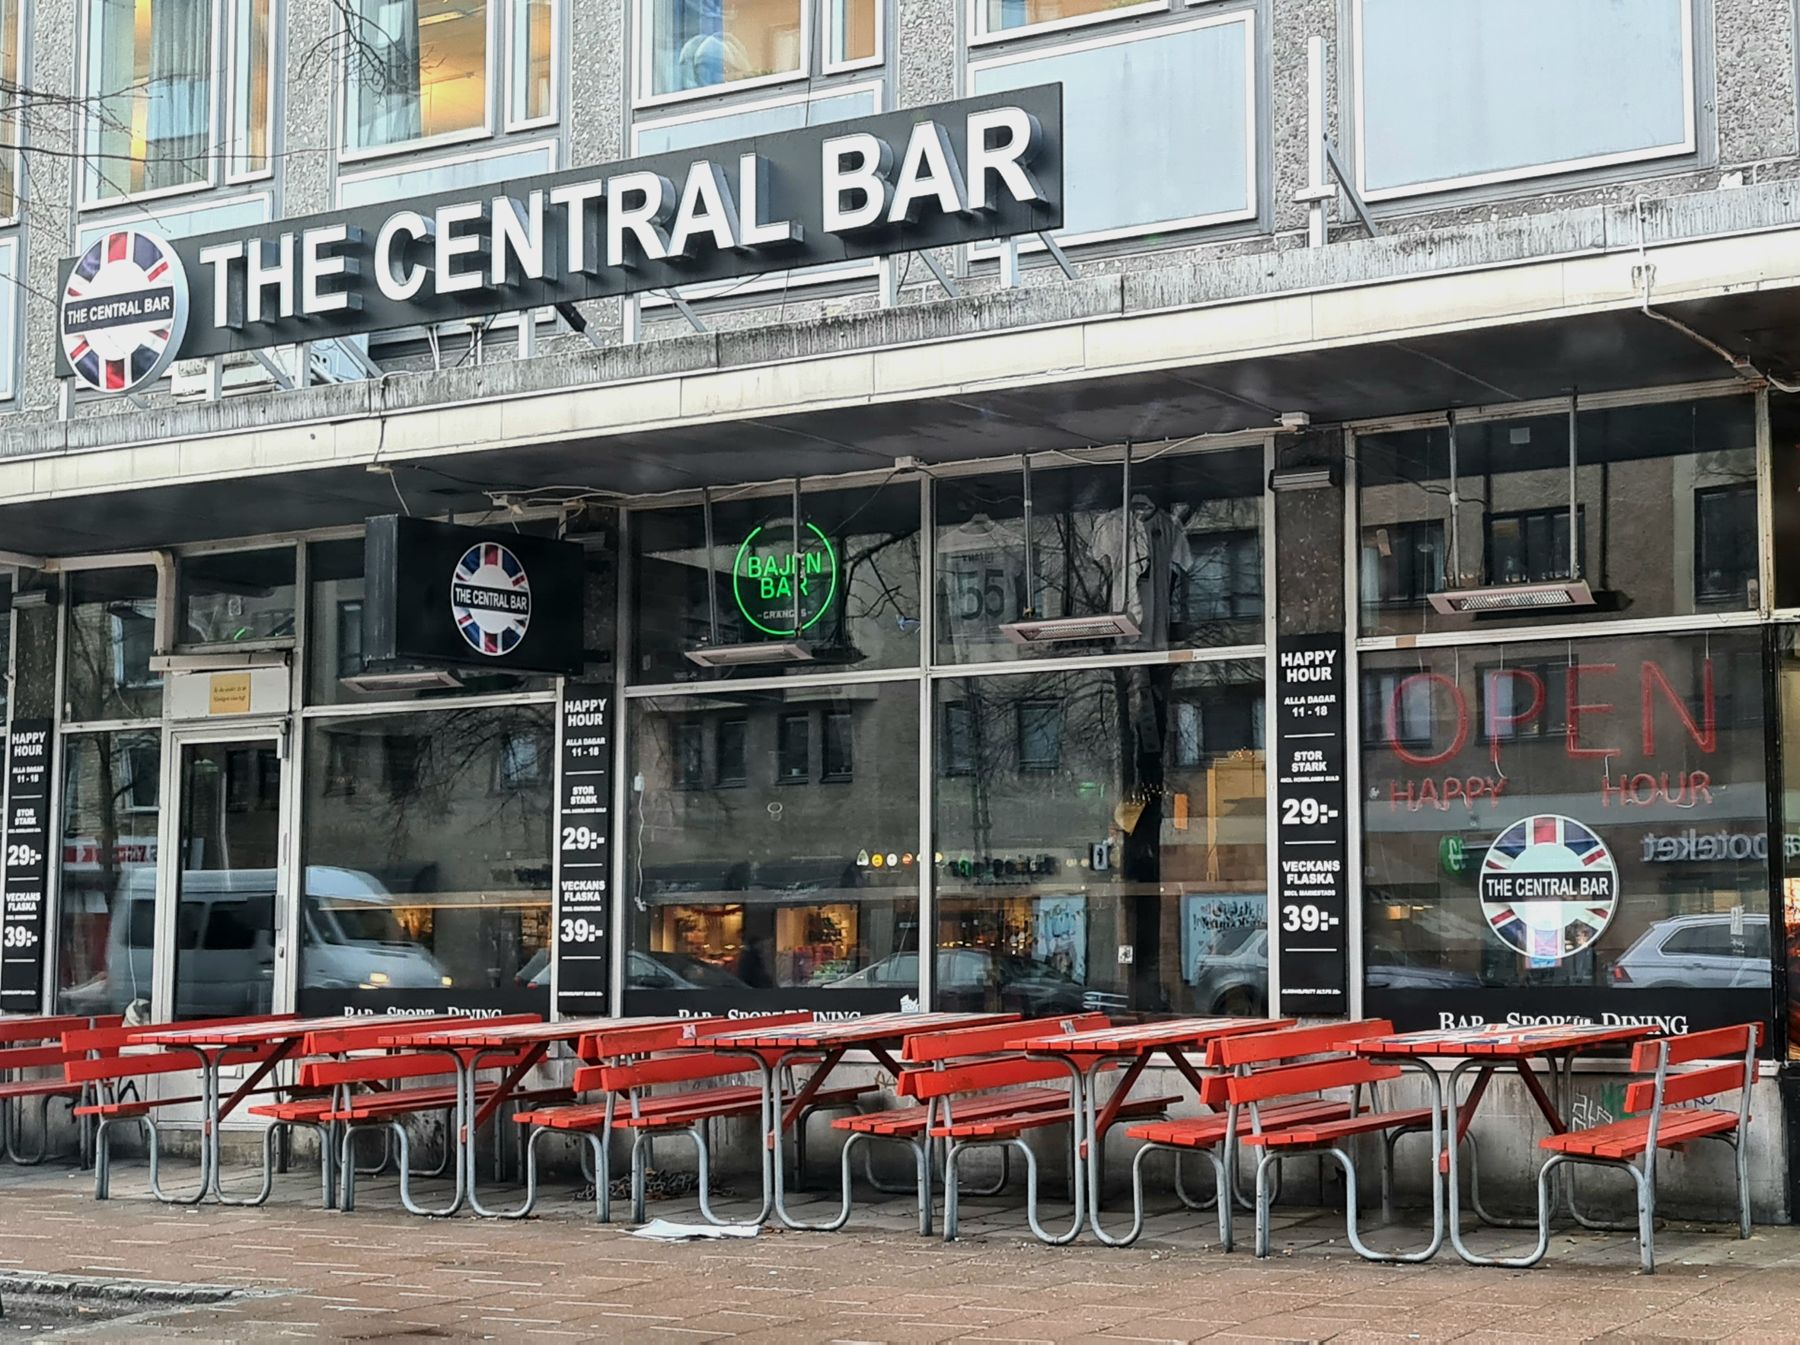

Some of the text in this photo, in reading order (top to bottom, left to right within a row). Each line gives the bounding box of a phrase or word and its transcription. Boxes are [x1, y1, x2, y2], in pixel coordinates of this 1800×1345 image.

[200, 106, 1037, 329] THE CENTRAL BAR
[67, 296, 170, 325] THE CENTRAL BAR
[748, 551, 821, 578] BAJN
[761, 576, 808, 599] BAR
[455, 587, 527, 610] THE CENTRAL BAR
[763, 608, 807, 619] GRANGS
[1281, 650, 1337, 667] HAPPY
[1287, 667, 1332, 683] HOUR
[565, 698, 607, 713] HAPPY
[1284, 696, 1306, 705] ALLA
[1292, 707, 1305, 717] 11
[1314, 706, 1328, 716] 18
[1386, 658, 1717, 766] OPEN
[568, 713, 603, 727] HOUR
[12, 731, 46, 745] HAPPY
[14, 745, 43, 757] HOUR
[572, 747, 581, 757] 11
[1294, 750, 1323, 761] STOR
[1291, 761, 1327, 773] STARK
[572, 785, 595, 796] STOR
[1389, 770, 1714, 811] HAPPY HOUR
[570, 795, 597, 805] STARK
[1282, 798, 1338, 825] 29:-
[562, 826, 605, 850] 29:-
[7, 844, 42, 866] 29:-
[1282, 860, 1341, 872] VECKANS
[561, 880, 606, 891] VECKANS
[1287, 873, 1335, 885] FLASKA
[1486, 877, 1609, 896] THE CENTRAL BAR
[564, 891, 601, 902] FLASKA
[1282, 904, 1339, 931] 39:-
[4, 925, 38, 947] 39:-
[560, 918, 603, 942] 39:-
